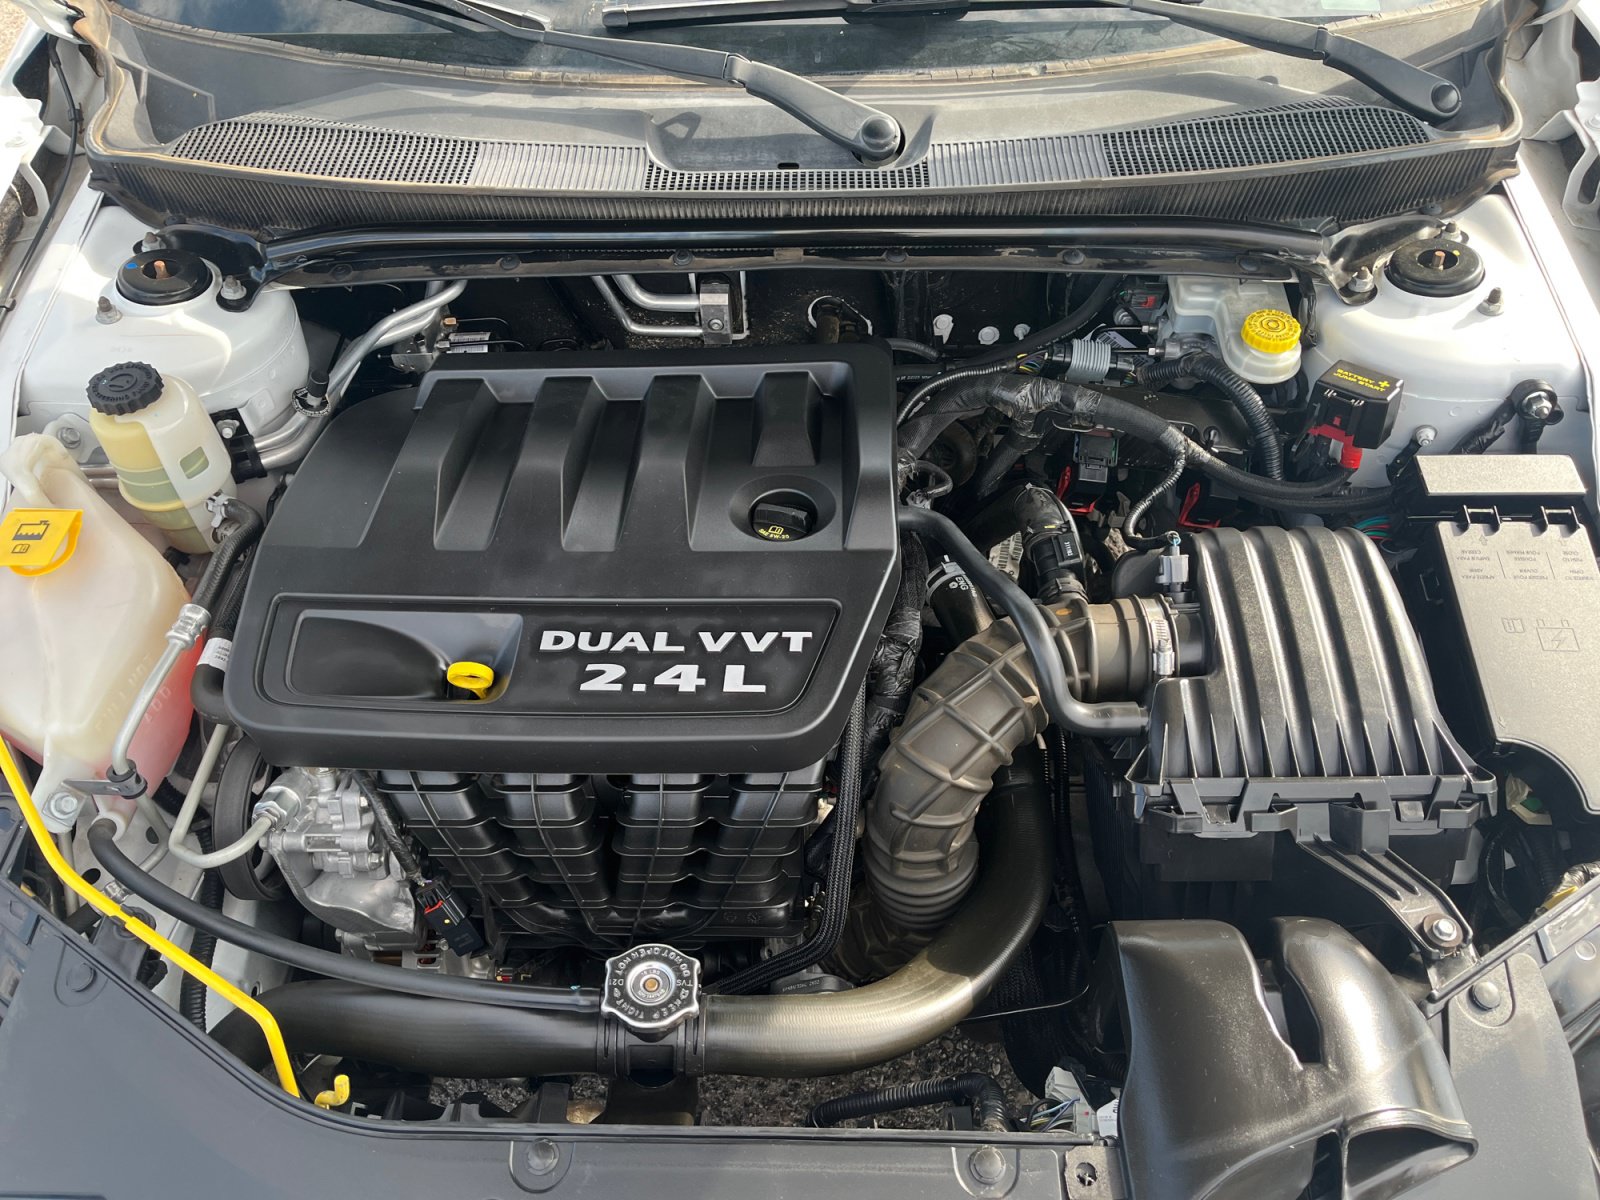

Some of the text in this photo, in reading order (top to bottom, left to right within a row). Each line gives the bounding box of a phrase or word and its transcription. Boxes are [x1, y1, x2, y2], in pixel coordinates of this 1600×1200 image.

[1333, 372, 1386, 392] JUMP START
[1336, 368, 1375, 384] BATTERY
[955, 576, 969, 590] ENG
[539, 630, 813, 653] DUAL VVT
[579, 663, 766, 693] 2.4 L
[614, 947, 691, 977] DO NOT OPEN HOT
[616, 998, 682, 1019] KEEP TIGHT
